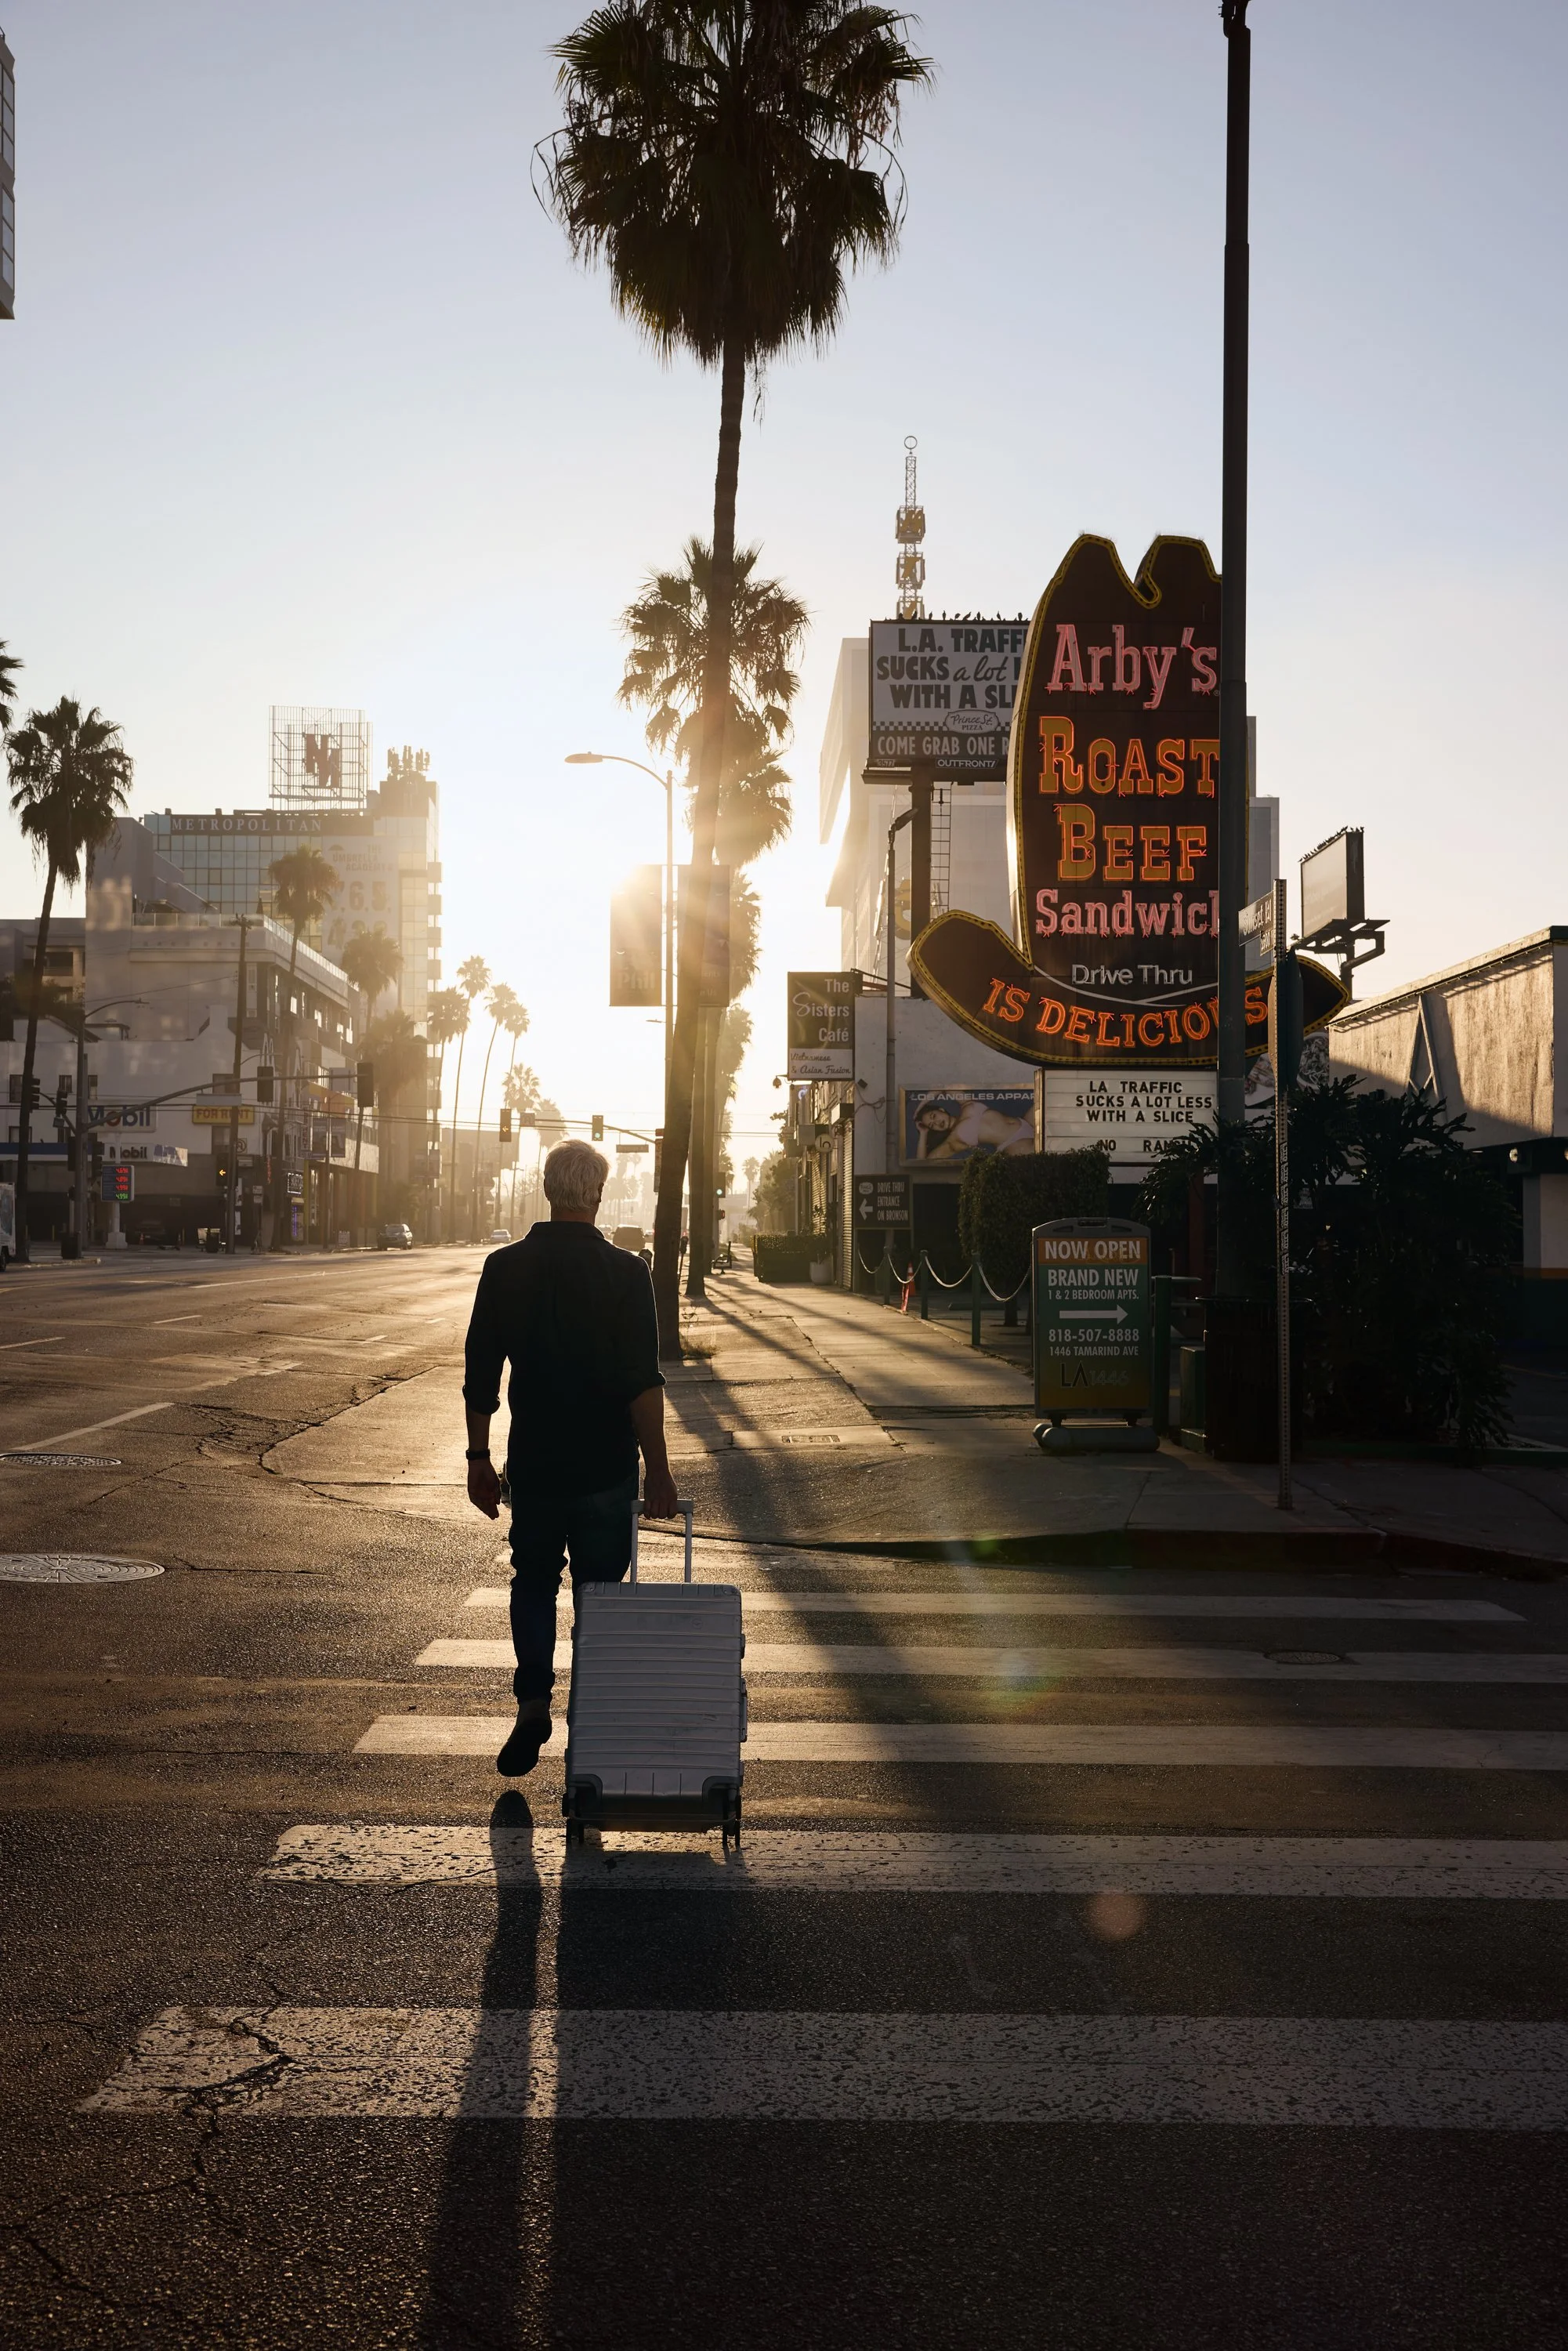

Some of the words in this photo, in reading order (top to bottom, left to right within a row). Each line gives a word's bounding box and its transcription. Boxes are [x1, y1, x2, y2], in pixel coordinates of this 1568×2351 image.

[898, 628, 943, 652] L.A.
[951, 629, 1028, 653] TRAFF
[876, 656, 950, 680] SUCKS
[953, 666, 970, 682] a
[973, 654, 1009, 682] lot
[1047, 625, 1217, 709] Arby's
[889, 684, 951, 708] WITH
[959, 684, 976, 709] A
[951, 714, 980, 726] Prince
[878, 736, 915, 755] COME
[922, 736, 960, 755] GRAB
[967, 737, 995, 755] ONE
[171, 819, 323, 831] METROPOLITAN
[1054, 803, 1207, 882] BEEF
[1243, 904, 1264, 936] Sunset
[1071, 964, 1133, 985] Drive
[1138, 964, 1193, 985] Thru
[824, 979, 849, 993] The
[792, 991, 849, 1017] Sisters
[983, 978, 1030, 1023] IS
[818, 1027, 849, 1042] Café
[791, 1052, 831, 1061] Vietnamese
[791, 1065, 797, 1074] &
[799, 1065, 823, 1074] Asian
[824, 1065, 852, 1074] Fusion
[1089, 1081, 1107, 1093] LA
[1121, 1081, 1182, 1093] TRAFFIC
[937, 1092, 994, 1101] ANGELES
[1076, 1096, 1124, 1107] SUCKS
[1131, 1096, 1141, 1107] A
[1146, 1096, 1170, 1108] LOT
[1178, 1096, 1212, 1109] LESS
[197, 1108, 218, 1118] FOR
[221, 1109, 251, 1119] RNT
[1087, 1110, 1126, 1122] WITH
[1136, 1110, 1145, 1122] A
[1153, 1110, 1193, 1122] SLICE
[1099, 1139, 1116, 1151] NO
[110, 1147, 147, 1159] Mobil
[878, 1182, 891, 1193] DRIVE
[893, 1182, 904, 1193] THRU
[878, 1196, 900, 1207] ENTRANCE
[878, 1210, 885, 1221] ON
[886, 1210, 908, 1221] BRONSON
[1045, 1241, 1088, 1259] NOW
[1095, 1241, 1141, 1259] OPEN
[1048, 1269, 1099, 1287] BRAND
[1105, 1269, 1139, 1286] NEW
[1055, 1290, 1062, 1300] &
[1064, 1290, 1070, 1300] 2
[1073, 1289, 1116, 1300] BEDROOM
[1117, 1289, 1139, 1300] APTS.
[1048, 1328, 1139, 1342] 818-507-8888
[1050, 1346, 1071, 1357] 1446
[1074, 1346, 1121, 1357] TAMARIND
[1123, 1346, 1139, 1356] AVE
